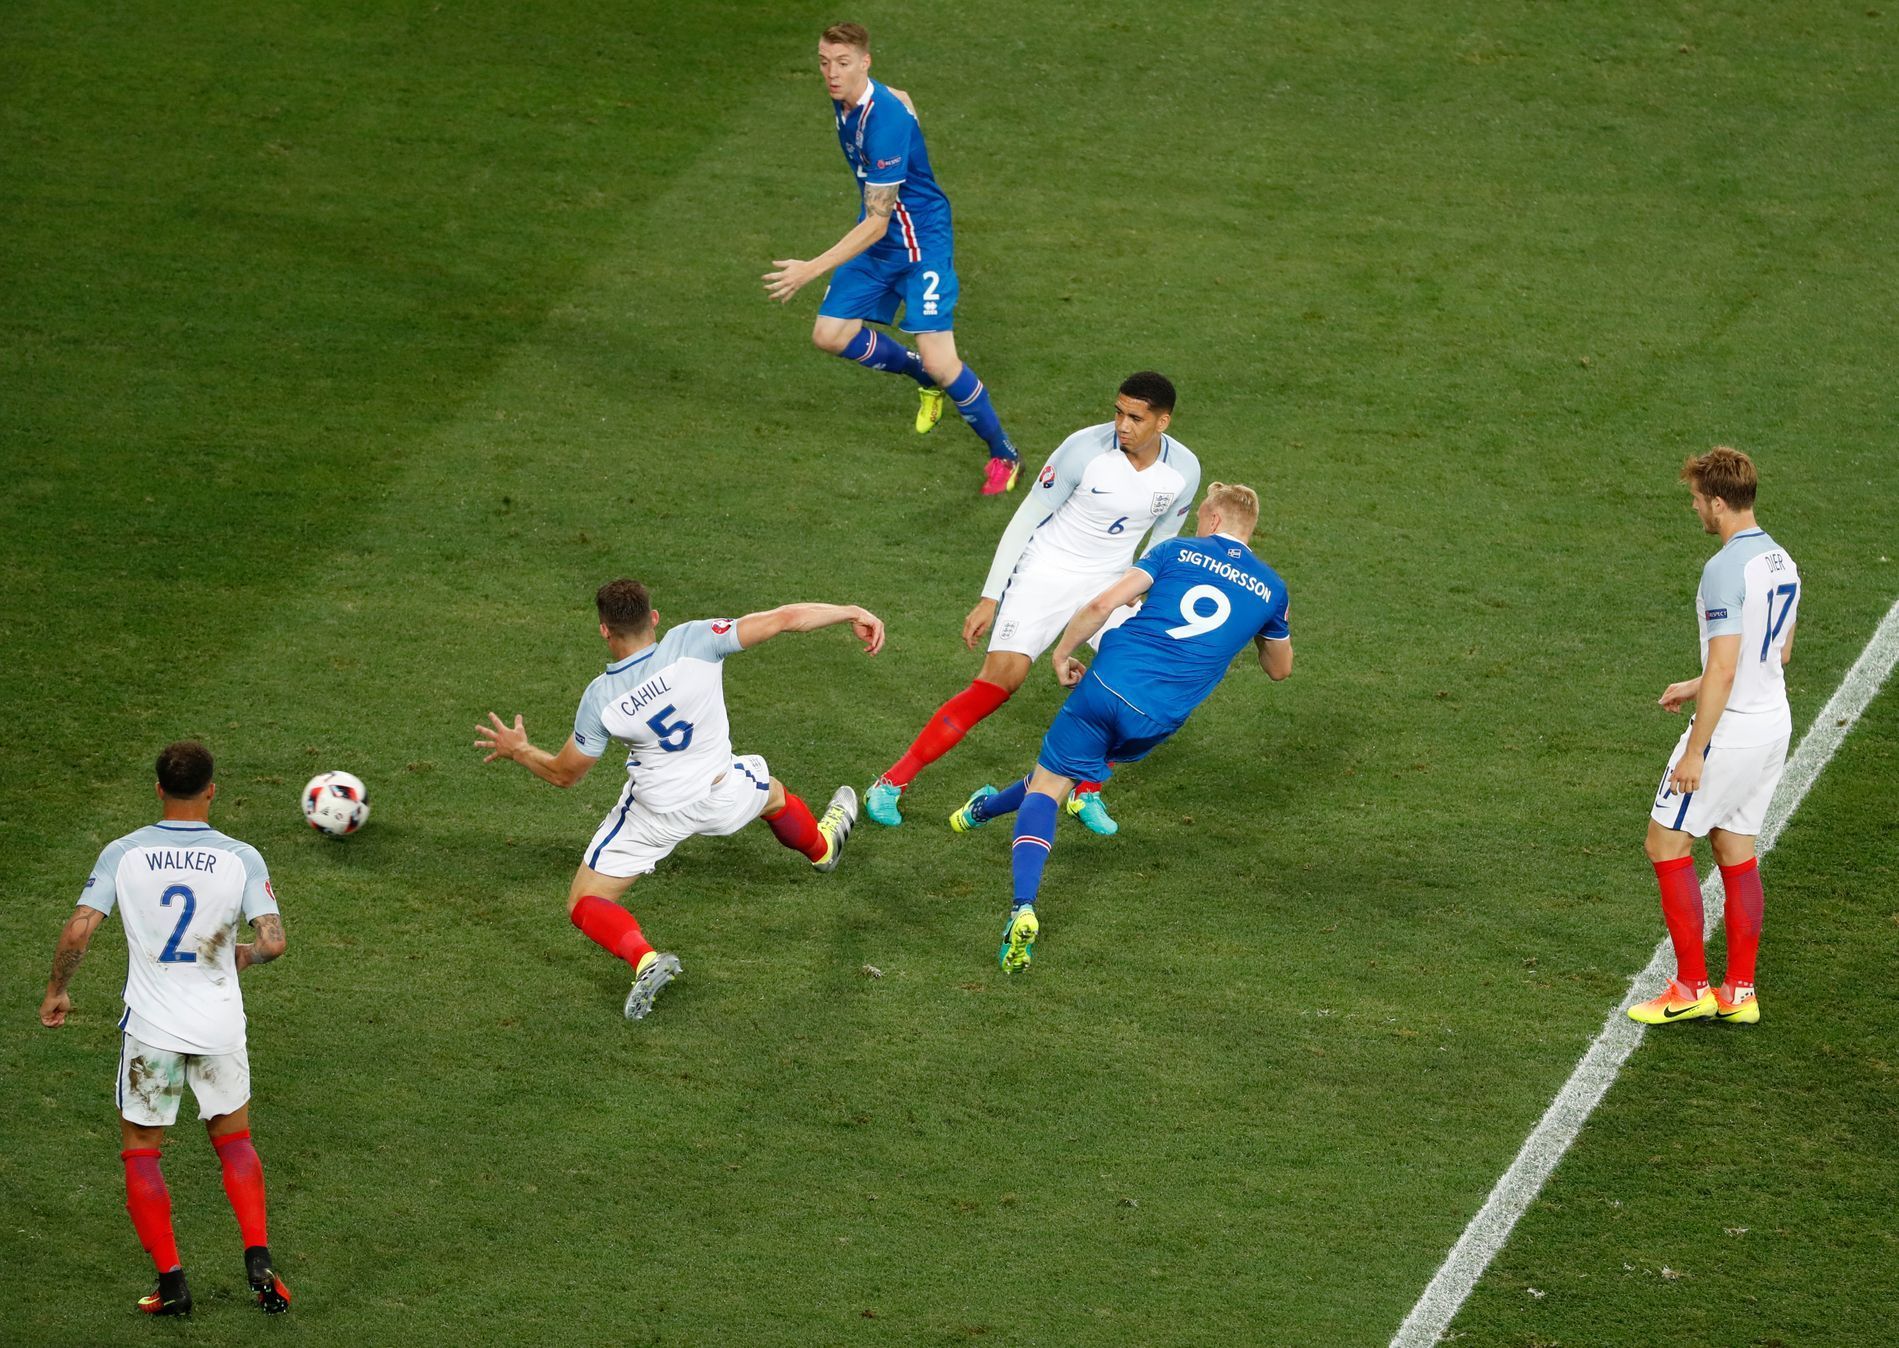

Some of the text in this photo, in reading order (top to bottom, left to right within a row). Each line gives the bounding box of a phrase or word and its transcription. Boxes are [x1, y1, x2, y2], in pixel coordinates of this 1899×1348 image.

[923, 271, 940, 300] 2
[1107, 516, 1129, 535] 6
[1177, 549, 1272, 603] SIGTHÓRSSON
[1765, 553, 1786, 573] DIER
[1165, 584, 1231, 640] 9
[1760, 582, 1797, 663] 17
[621, 676, 672, 717] CAHILL
[645, 703, 694, 753] 5
[145, 851, 217, 874] WALKER
[156, 883, 197, 963] 2
